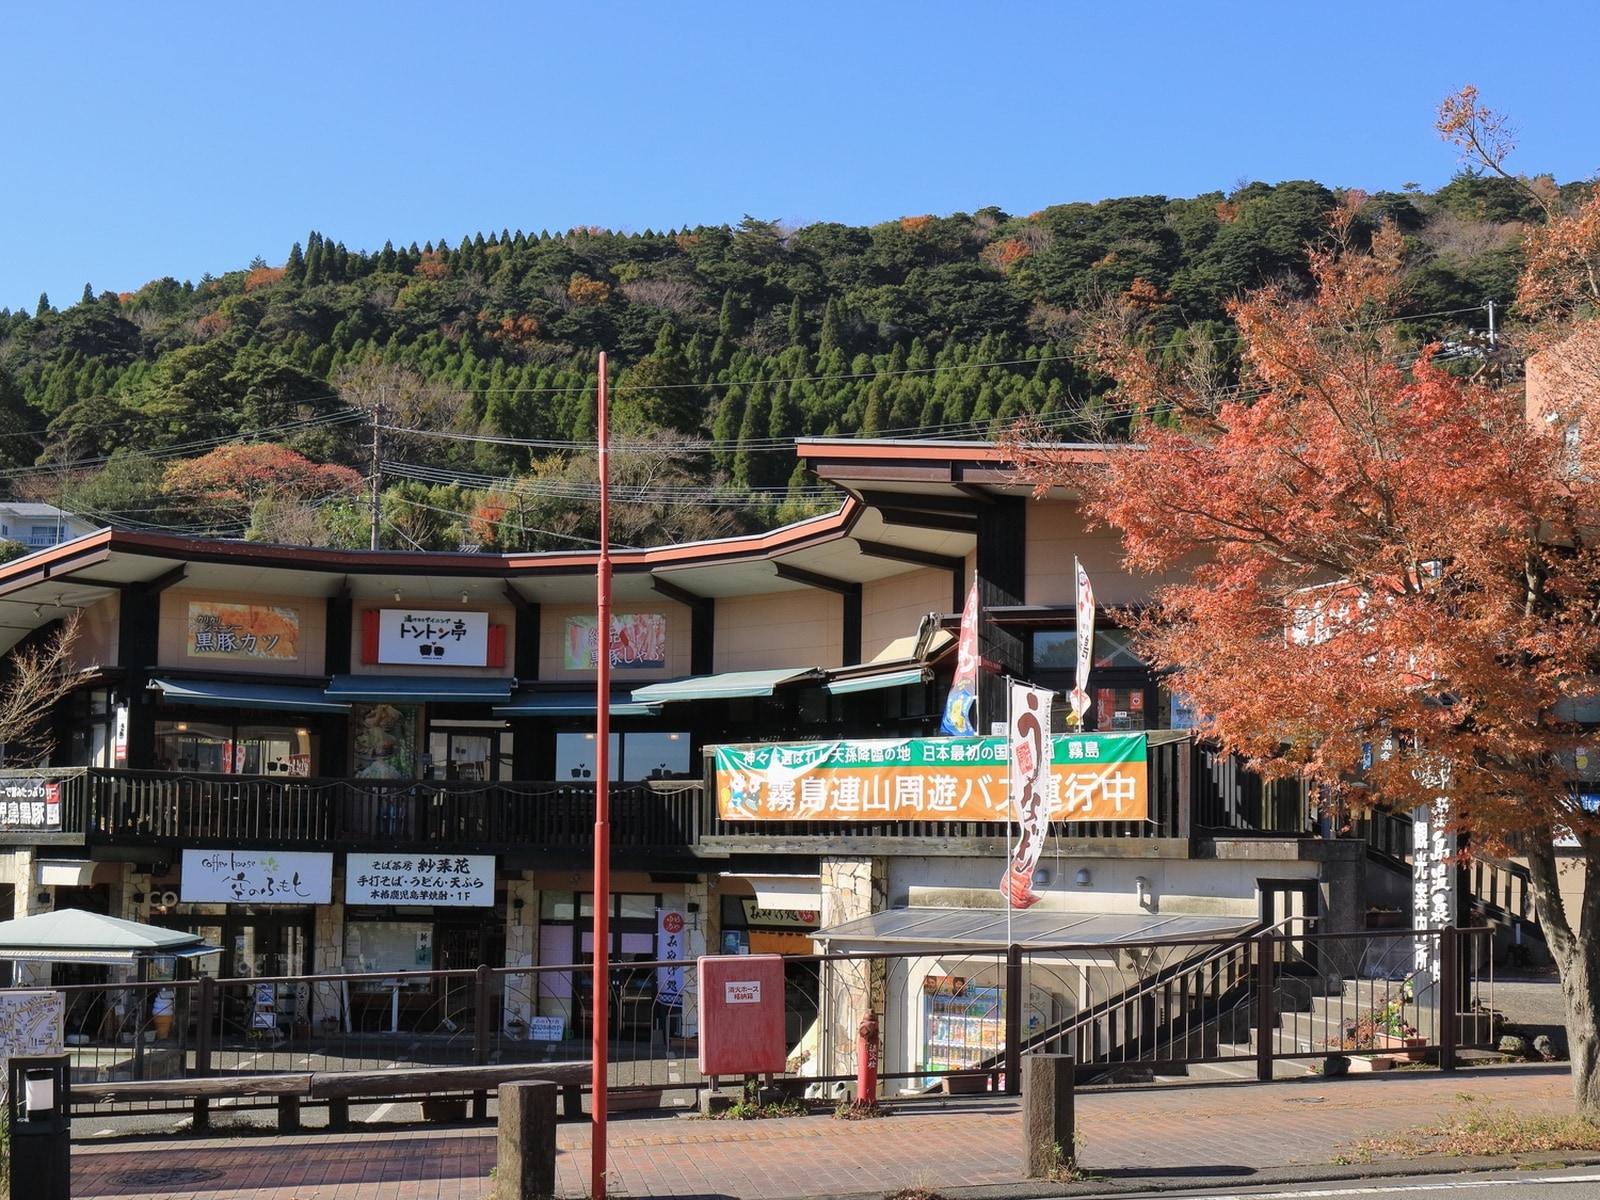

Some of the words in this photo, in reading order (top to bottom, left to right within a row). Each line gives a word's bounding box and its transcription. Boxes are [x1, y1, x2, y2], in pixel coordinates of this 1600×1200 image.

[197, 616, 222, 625] カリカリ
[204, 624, 243, 632] ジューシー
[401, 619, 467, 641] トントン亭
[195, 632, 279, 652] 黒豚カツ
[923, 740, 1055, 762] 日本最初の国
[1068, 741, 1099, 759] 霧島
[231, 852, 256, 871] house
[372, 860, 413, 871] そば茶房
[1414, 821, 1429, 972] 観光案内所
[727, 985, 759, 993] 消火ホース
